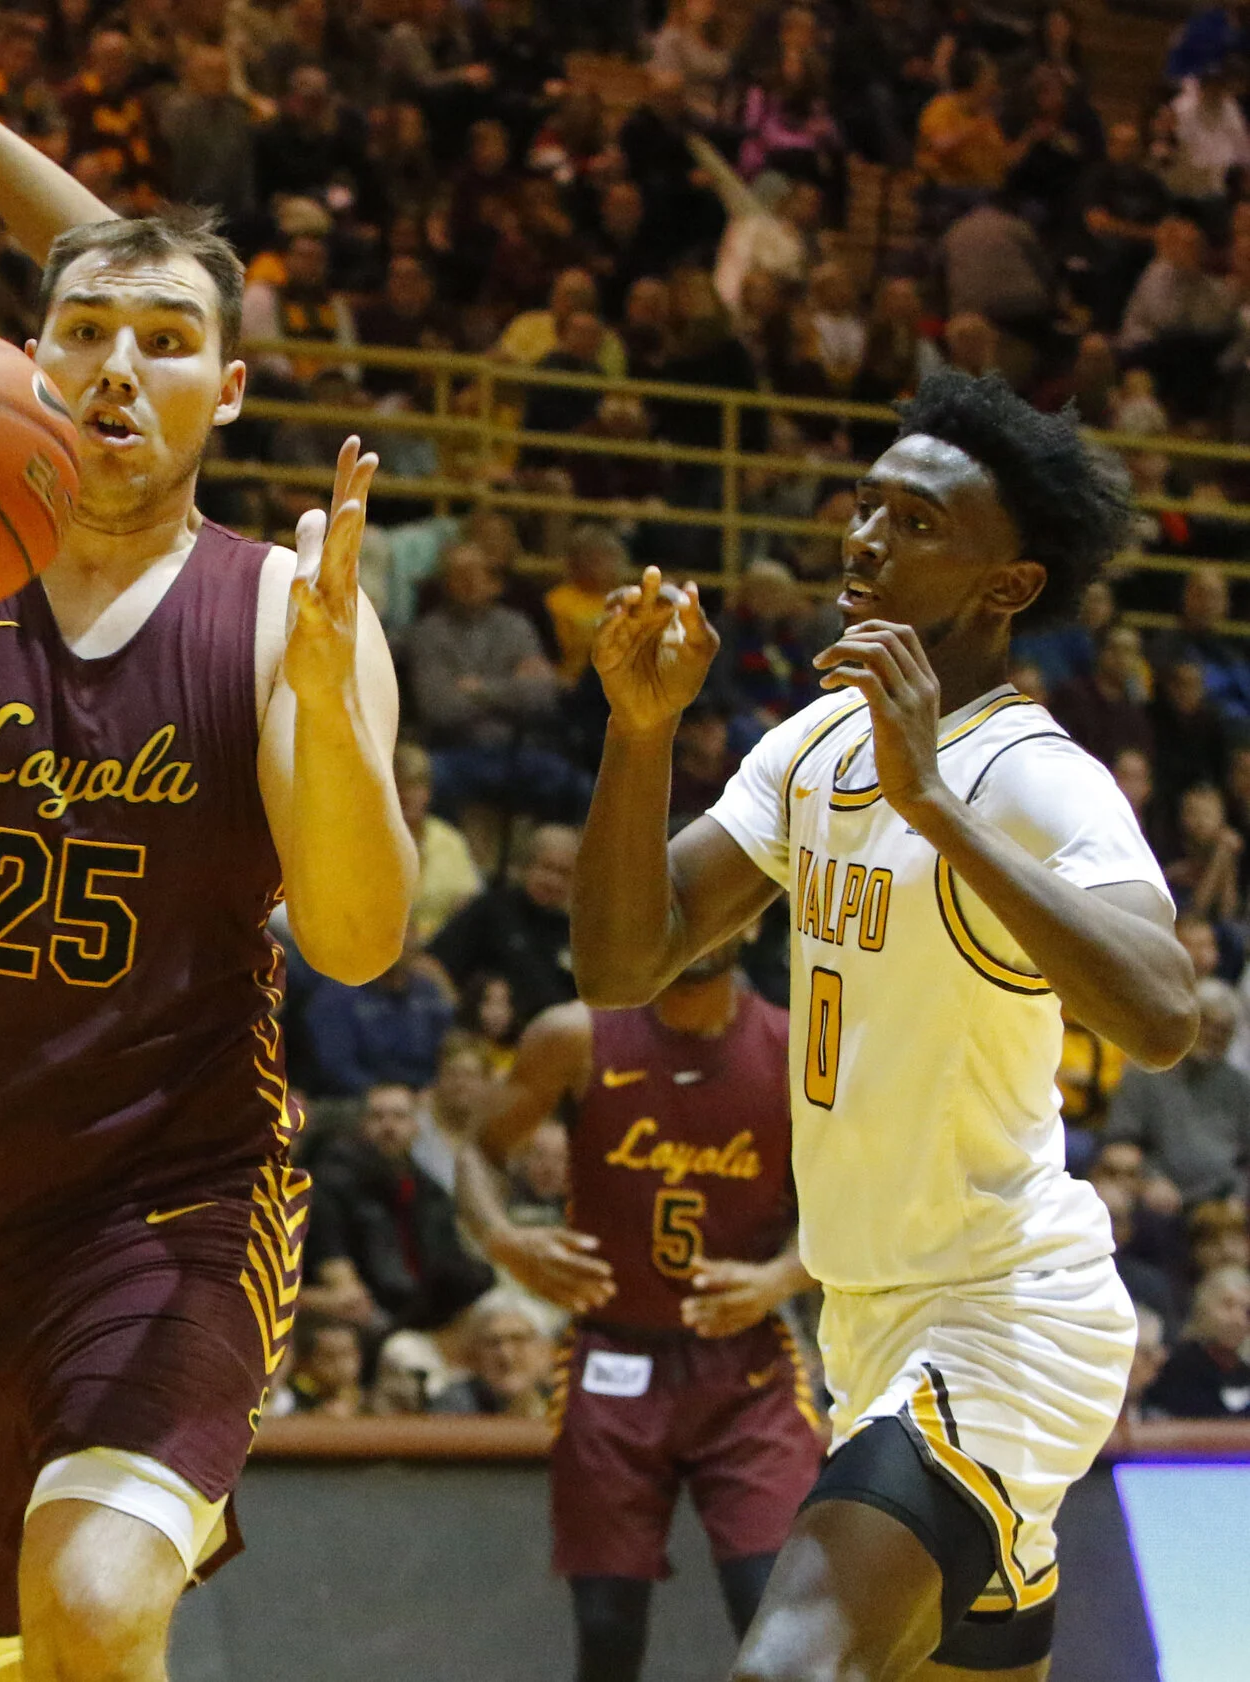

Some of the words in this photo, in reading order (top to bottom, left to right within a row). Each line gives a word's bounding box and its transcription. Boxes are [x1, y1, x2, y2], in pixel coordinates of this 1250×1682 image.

[797, 846, 893, 952] VALPO
[804, 965, 843, 1111] 0
[606, 1117, 763, 1185] Loyola
[651, 1188, 706, 1281] 5
